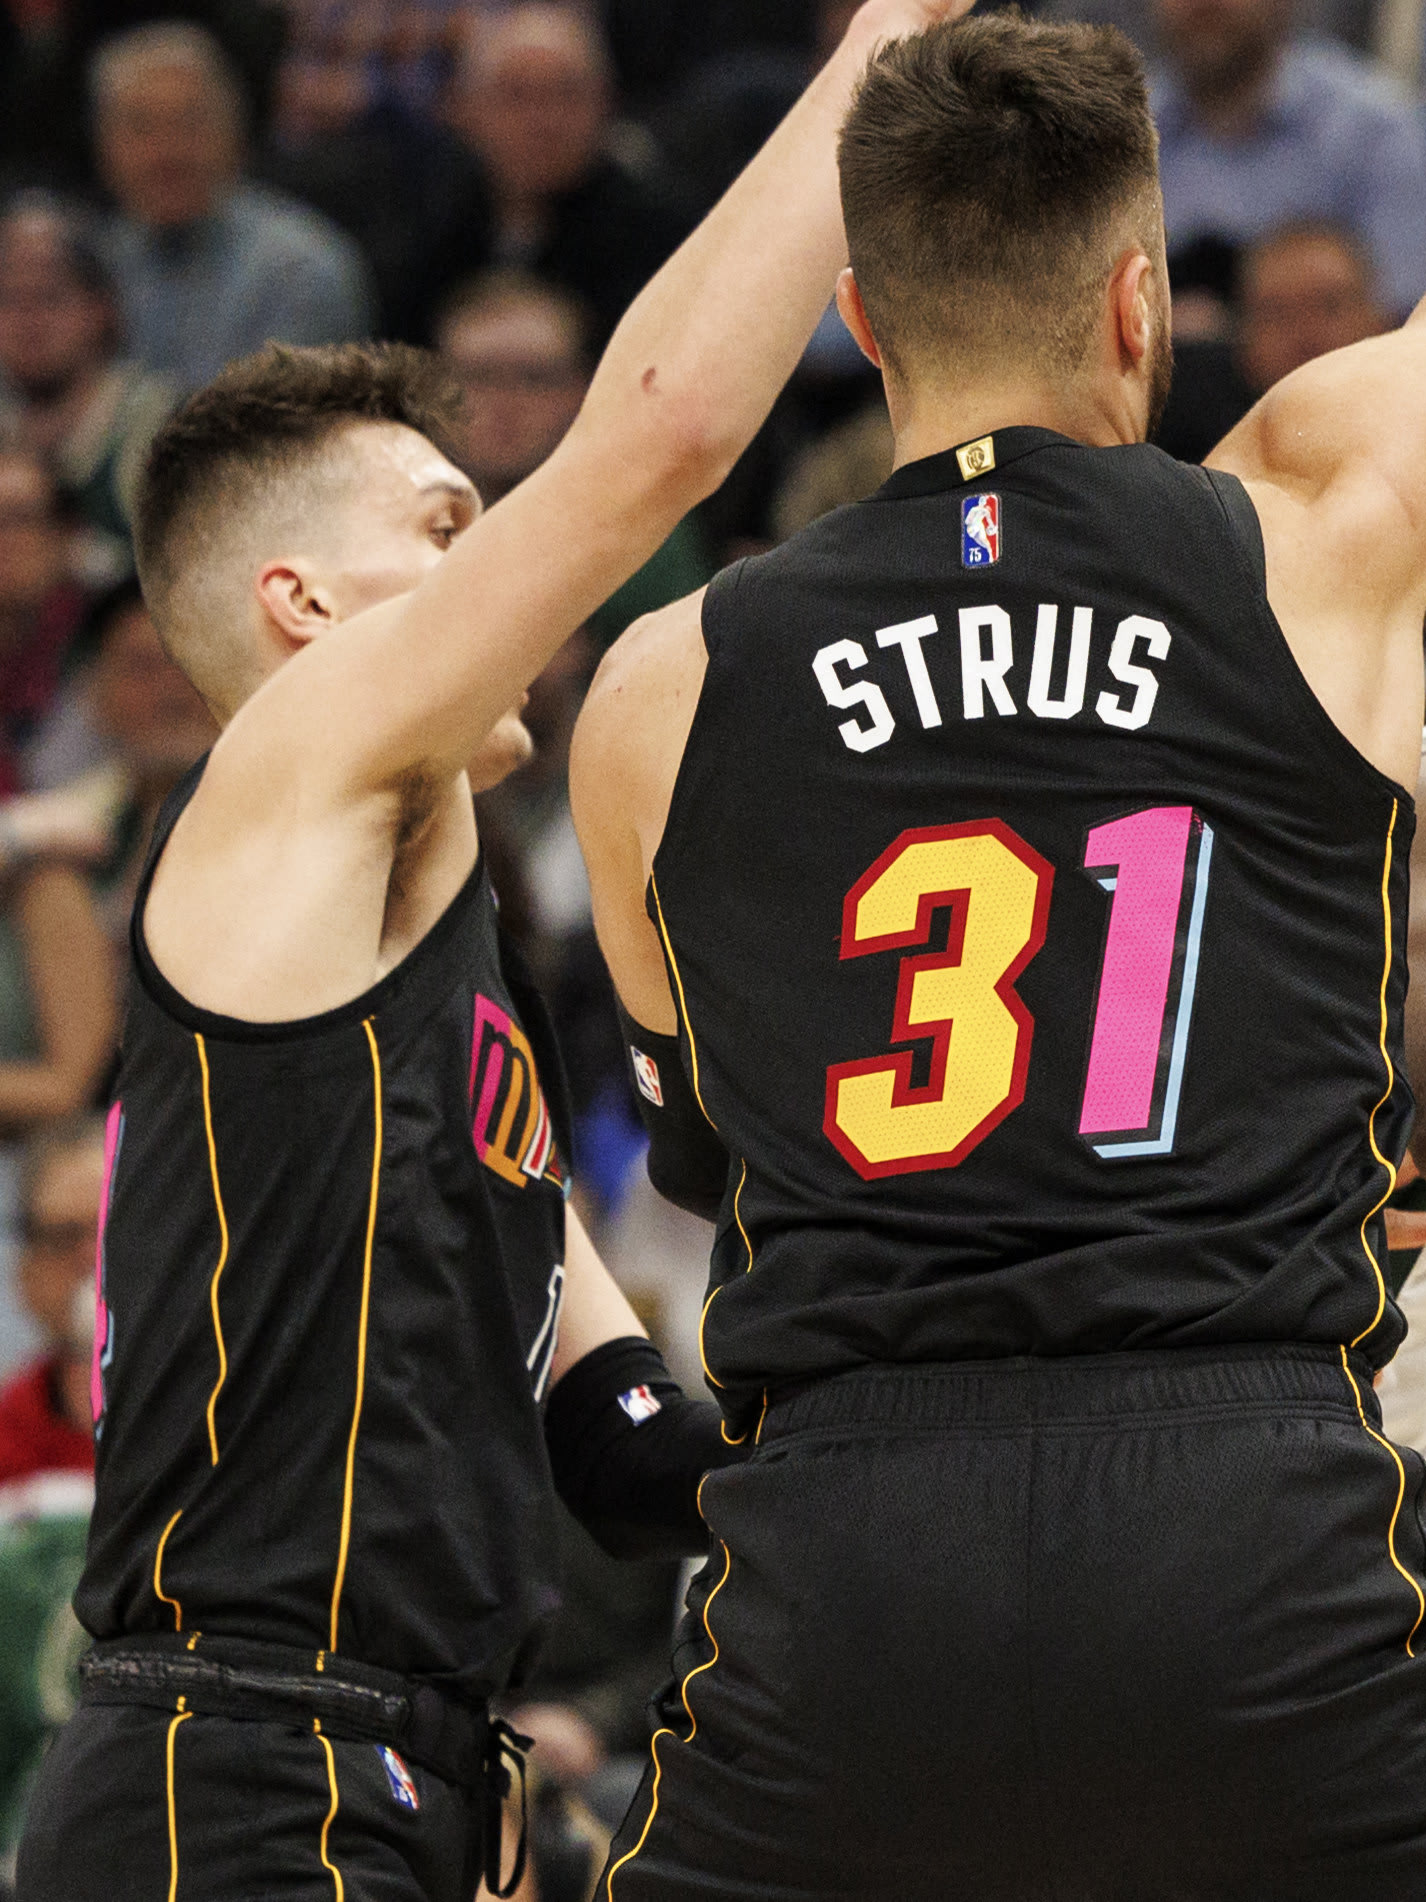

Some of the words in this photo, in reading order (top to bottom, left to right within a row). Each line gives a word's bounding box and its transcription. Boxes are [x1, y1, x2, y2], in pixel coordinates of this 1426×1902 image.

[968, 547, 982, 563] 75
[811, 603, 1172, 753] STRUS
[822, 806, 1214, 1181] 31
